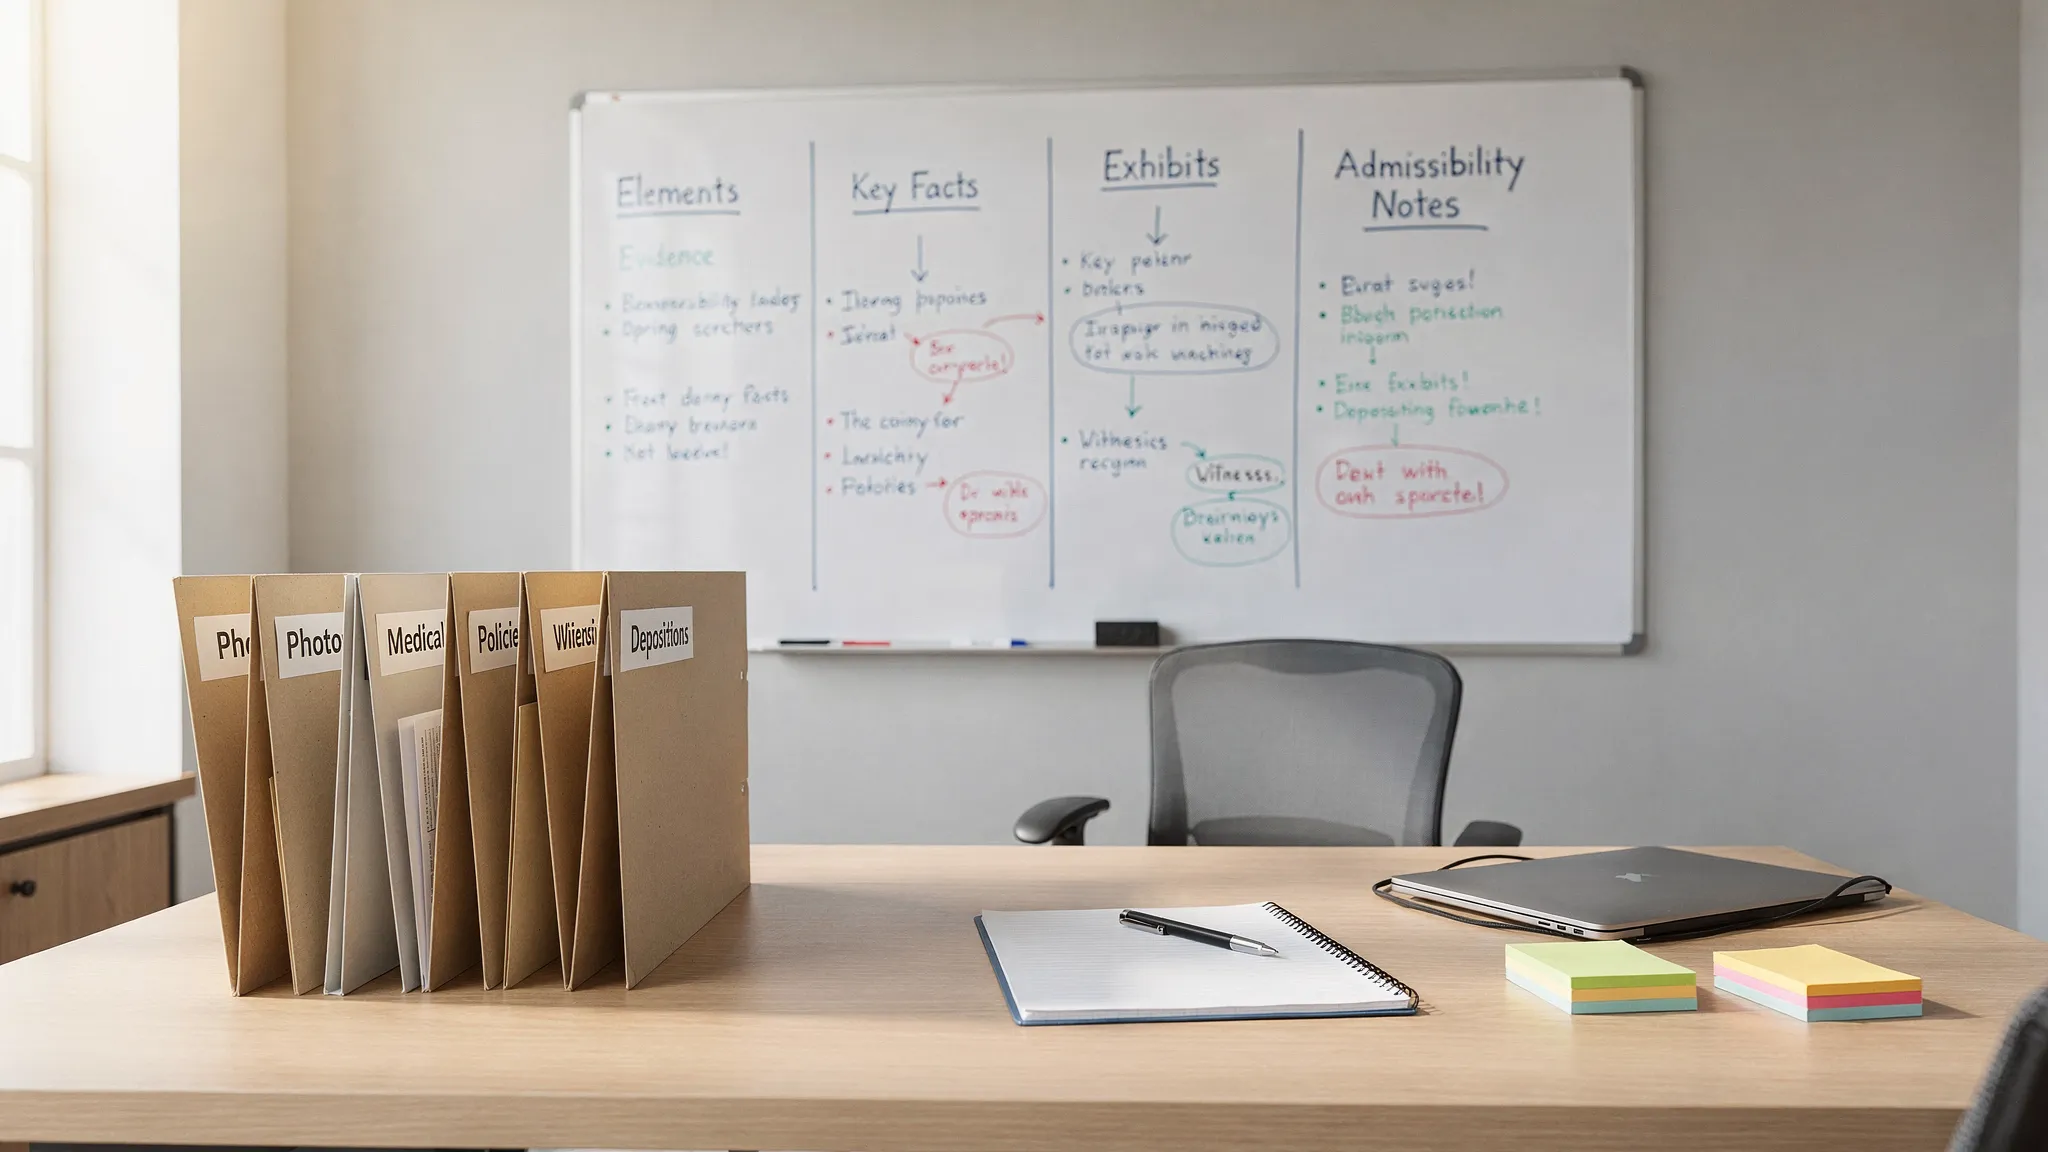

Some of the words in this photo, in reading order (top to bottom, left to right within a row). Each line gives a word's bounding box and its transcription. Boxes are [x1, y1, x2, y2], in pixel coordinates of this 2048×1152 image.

[1103, 145, 1221, 181] Exhibits
[1334, 144, 1525, 193] Admissibility
[617, 173, 740, 208] Elements
[851, 172, 897, 213] Key
[910, 170, 979, 201] Facts
[1371, 188, 1462, 219] Notes
[1080, 250, 1114, 275] Key
[1170, 314, 1191, 333] in
[841, 410, 872, 431] The
[1402, 460, 1448, 480] with
[286, 627, 344, 660] Photo
[387, 620, 445, 656] Medical
[477, 620, 519, 654] Policie
[630, 620, 690, 660] Depositions
